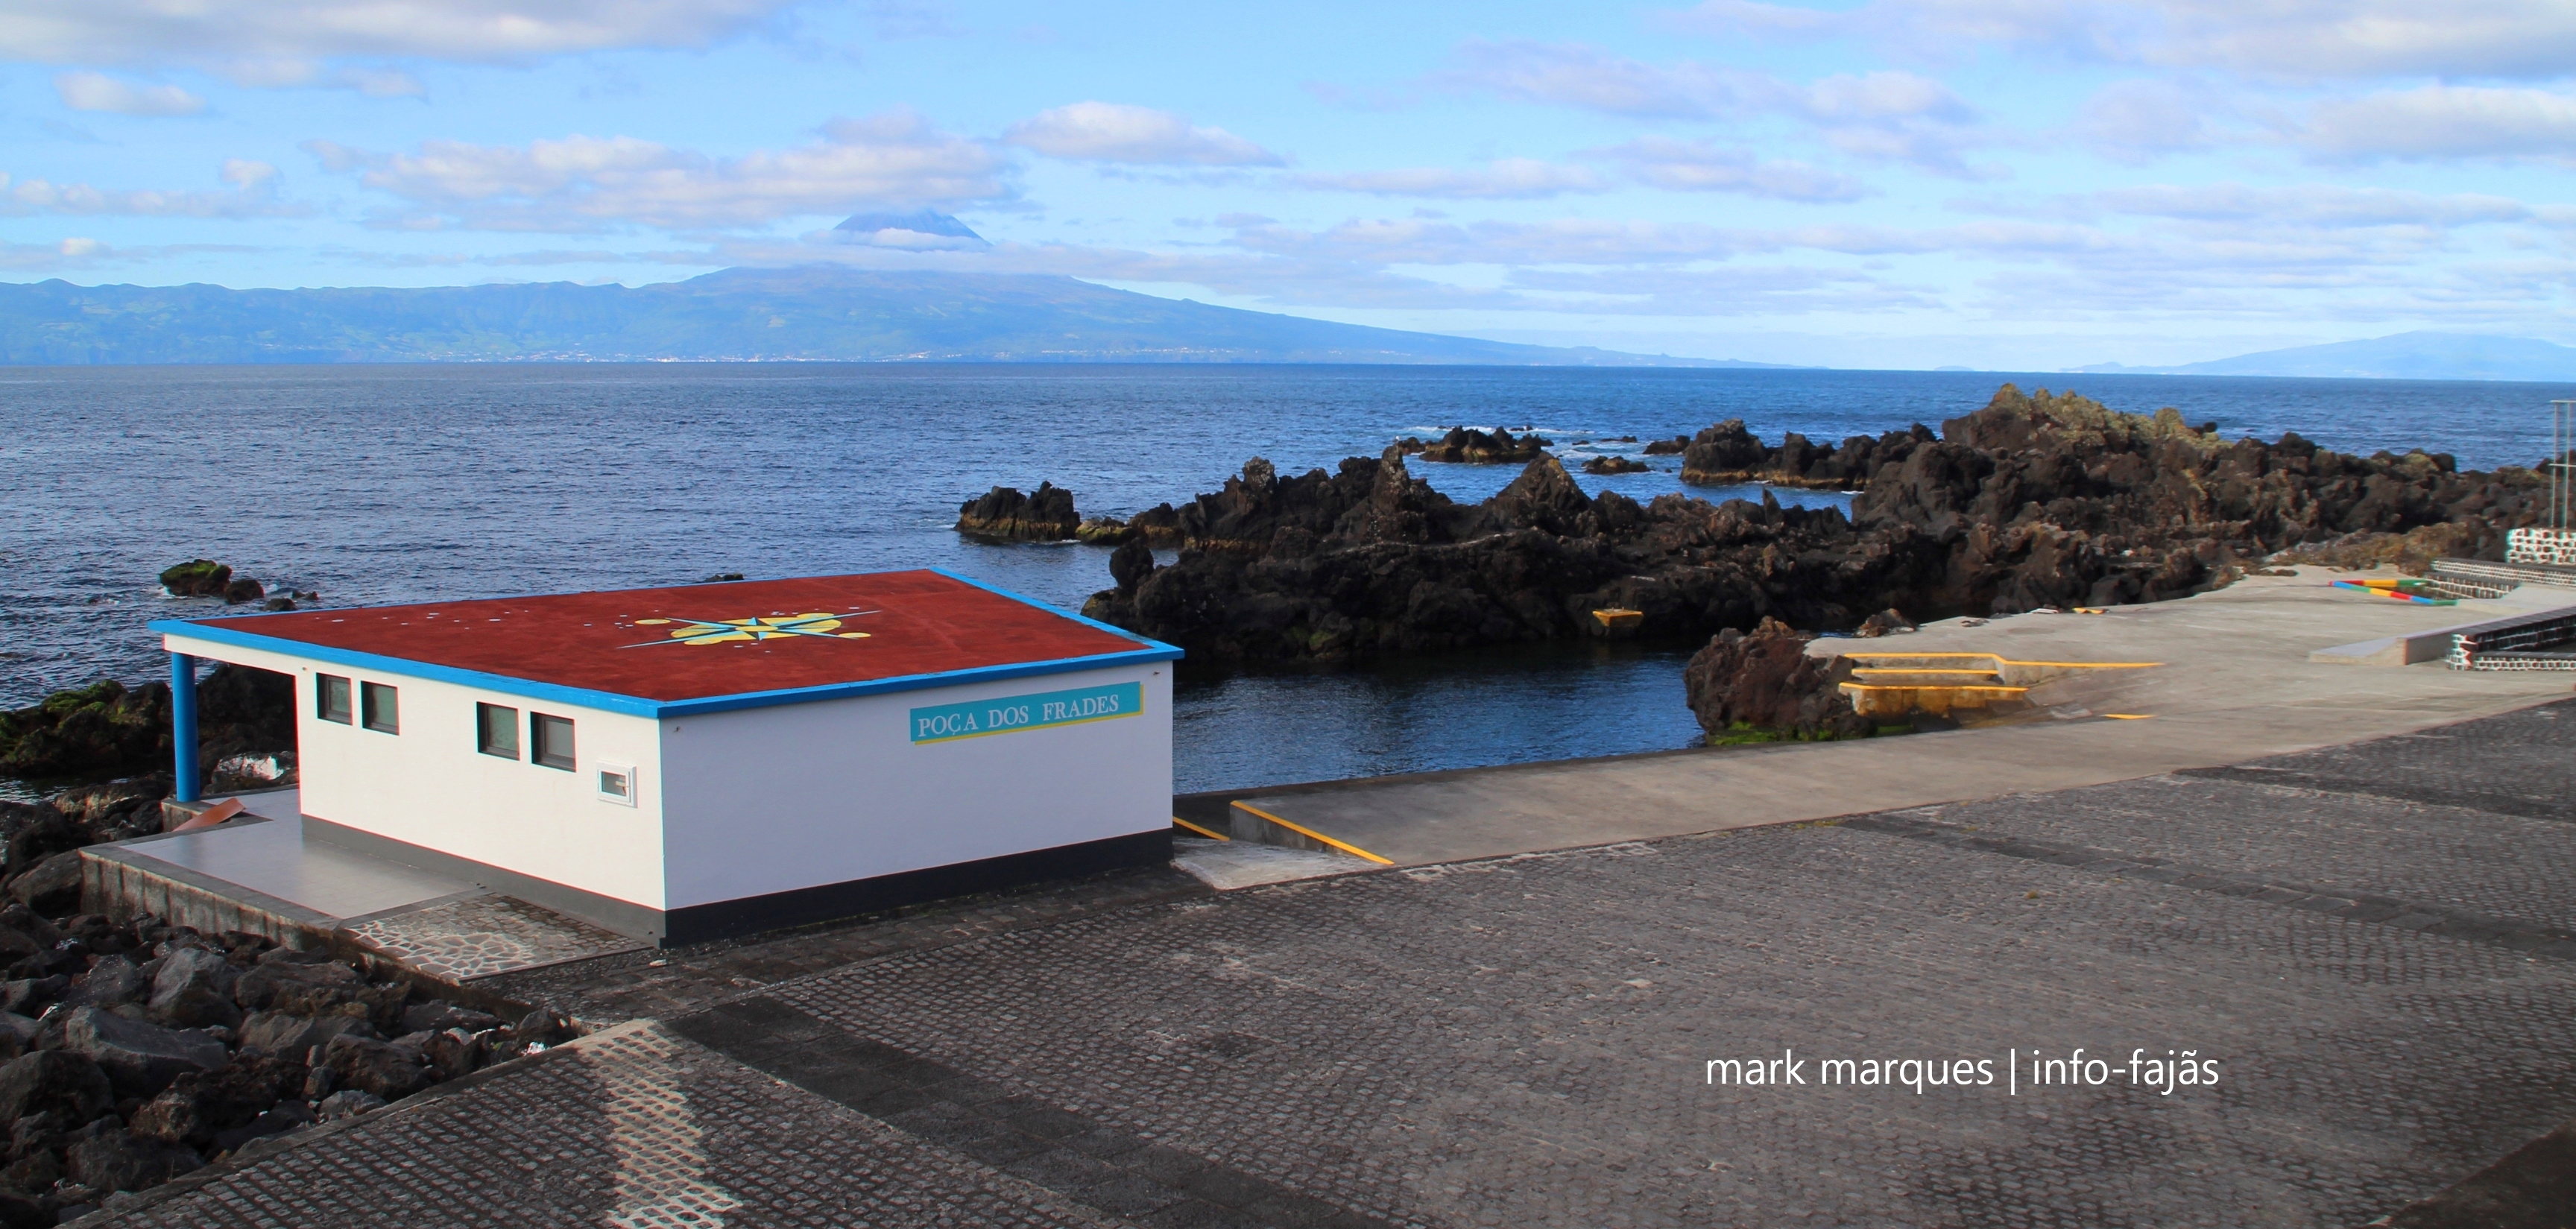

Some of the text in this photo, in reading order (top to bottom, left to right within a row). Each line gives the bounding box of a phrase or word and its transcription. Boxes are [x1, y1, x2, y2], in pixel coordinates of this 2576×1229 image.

[918, 694, 1120, 737] POÇA DOS FRADES
